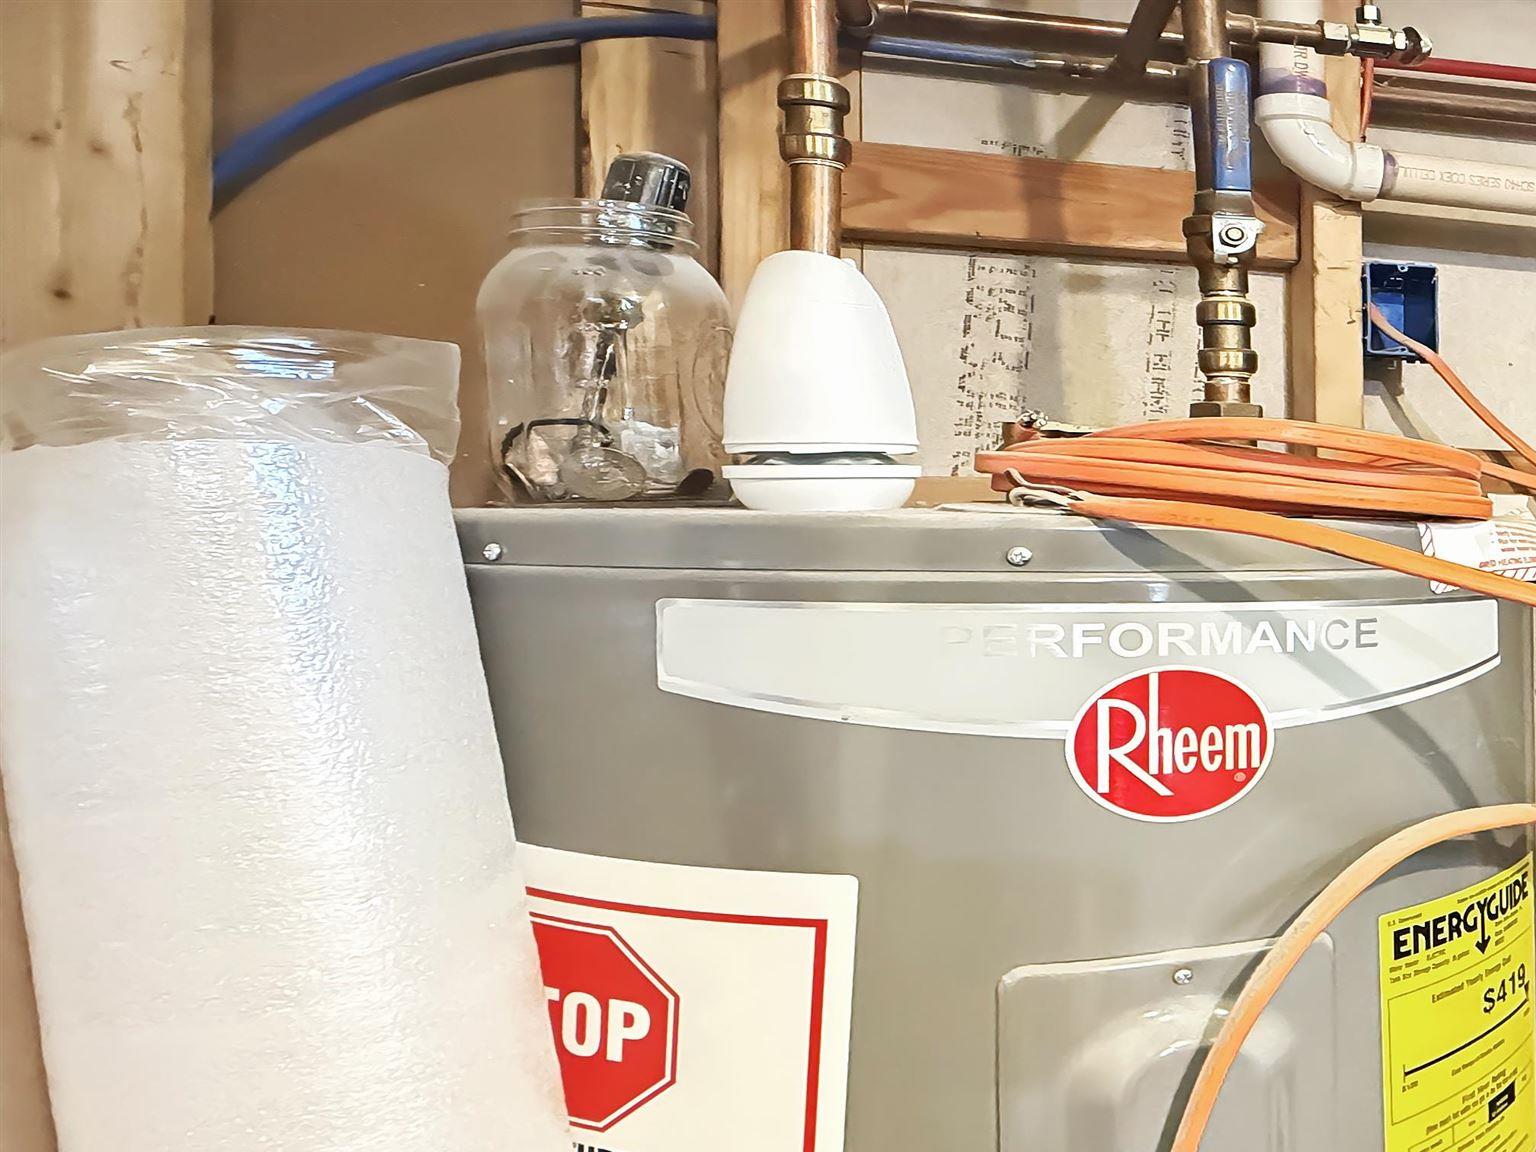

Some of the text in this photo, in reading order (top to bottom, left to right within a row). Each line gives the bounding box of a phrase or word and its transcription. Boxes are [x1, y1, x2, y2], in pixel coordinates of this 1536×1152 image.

[1469, 174, 1502, 189] SERIES
[943, 615, 1380, 660] PERFORMANCE
[1095, 671, 1264, 797] Rheem
[1393, 871, 1529, 961] ENERGYGUIDE
